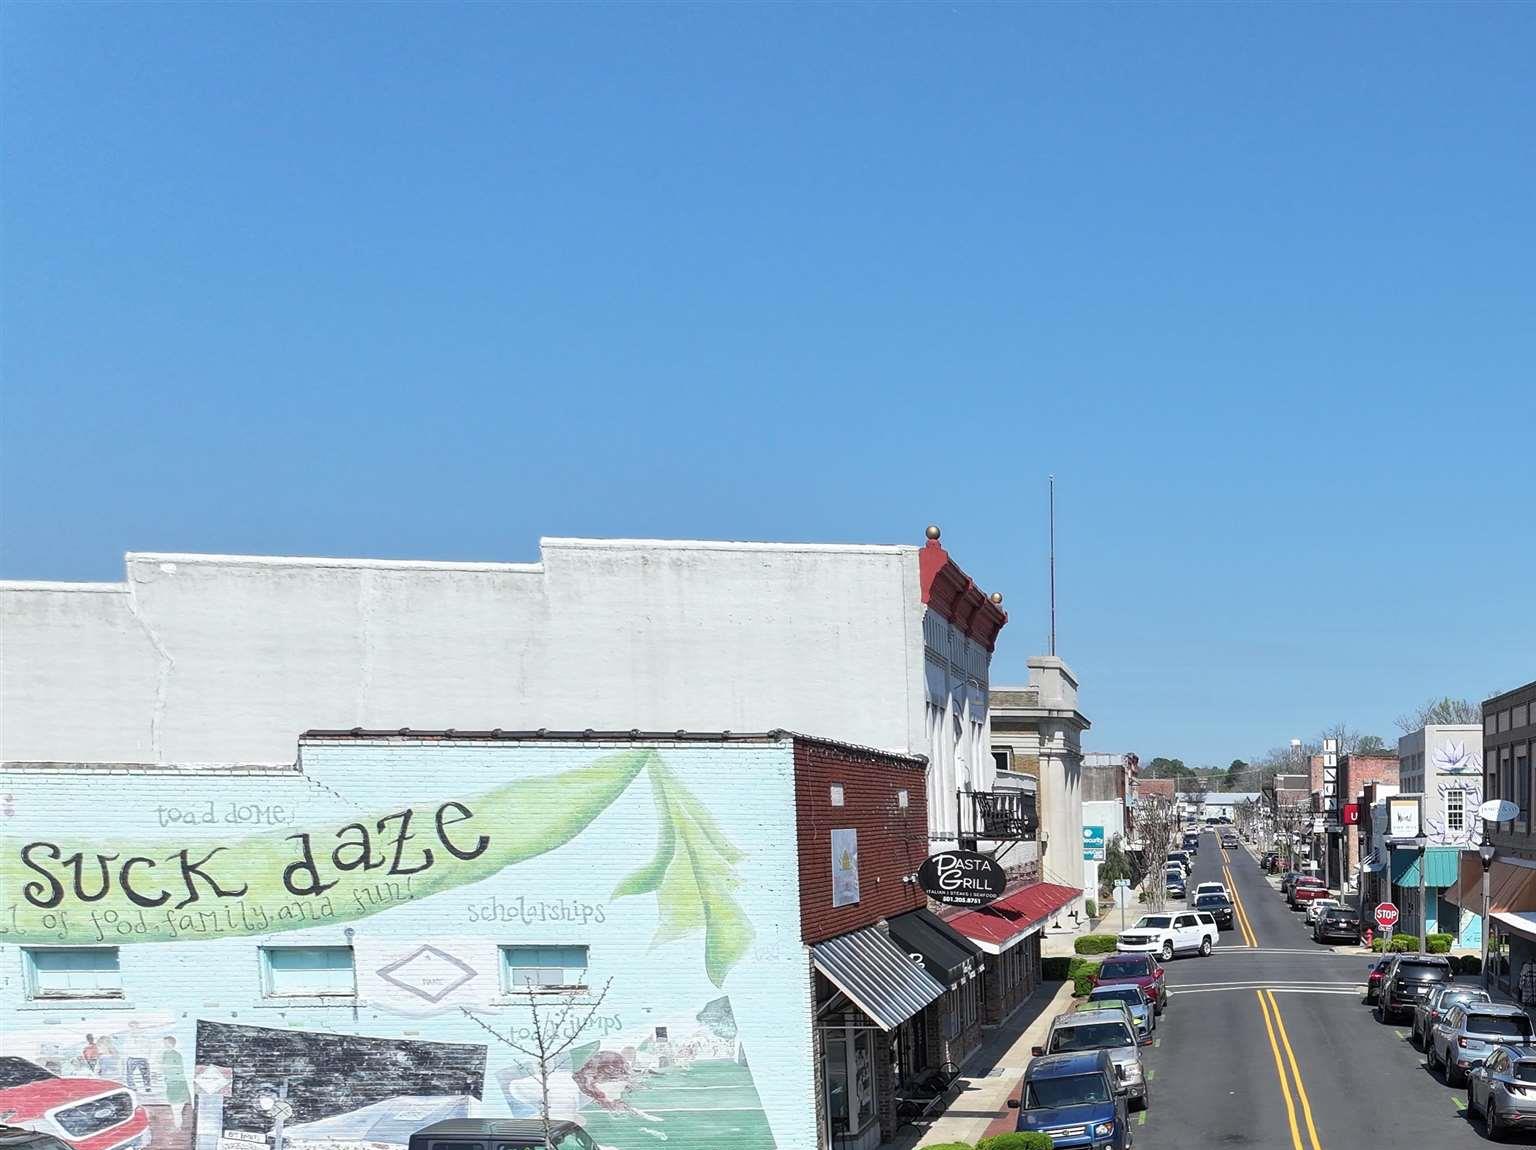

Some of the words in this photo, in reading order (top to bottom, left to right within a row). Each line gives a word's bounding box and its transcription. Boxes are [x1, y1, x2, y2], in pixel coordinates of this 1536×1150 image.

[157, 800, 219, 828] toad
[932, 854, 992, 876] PASTA
[939, 869, 993, 890] GRILL
[43, 911, 68, 940] of
[279, 897, 336, 921] and
[353, 877, 414, 915] fun!
[467, 896, 606, 926] scholarships
[1377, 909, 1397, 919] STOP
